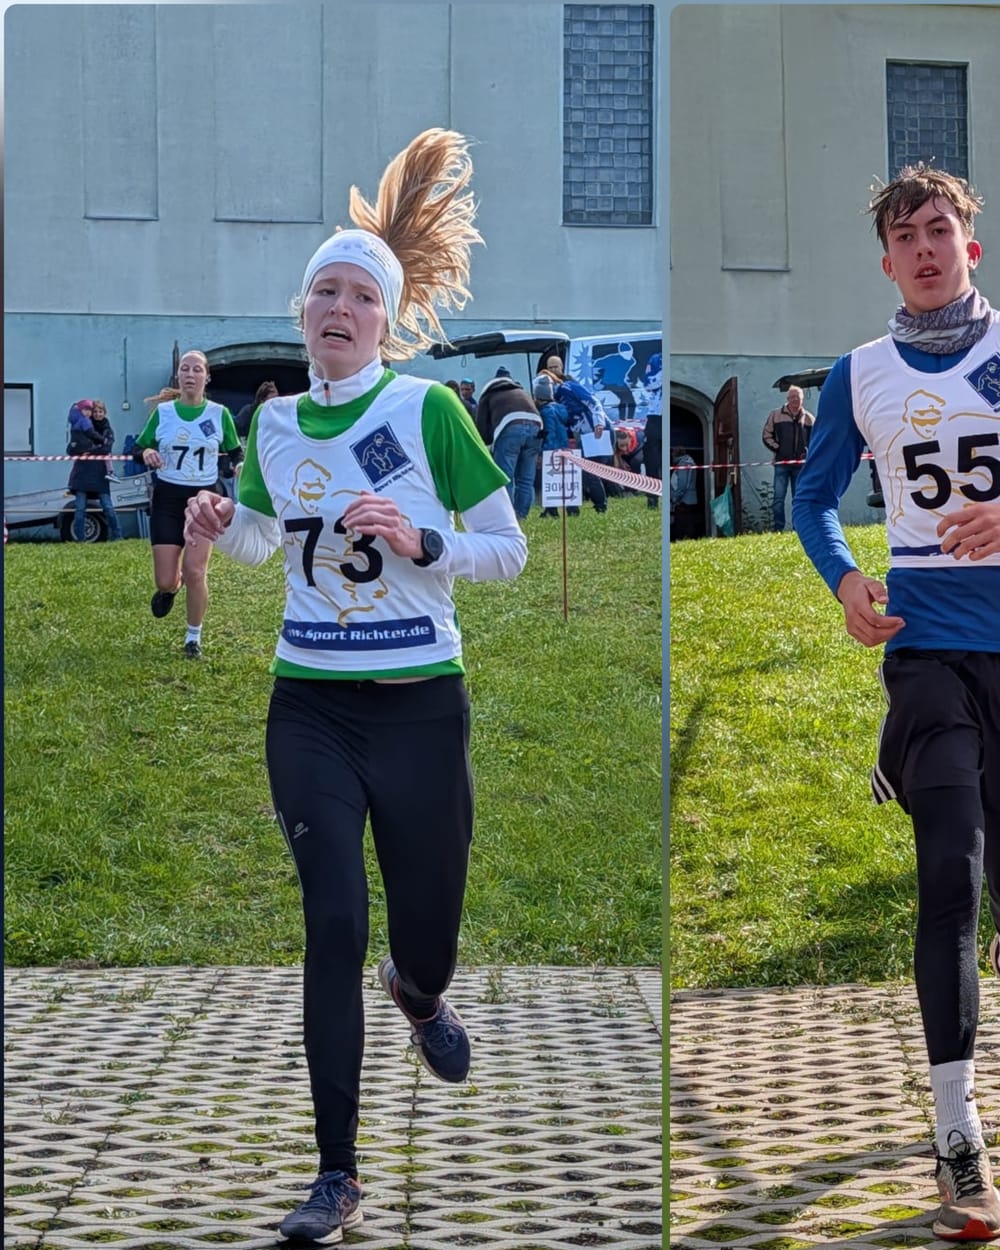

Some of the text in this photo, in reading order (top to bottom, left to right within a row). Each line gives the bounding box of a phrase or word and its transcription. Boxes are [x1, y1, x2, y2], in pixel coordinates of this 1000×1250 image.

[172, 445, 206, 471] 71
[284, 515, 383, 587] 73
[350, 625, 430, 641] Richter.de
